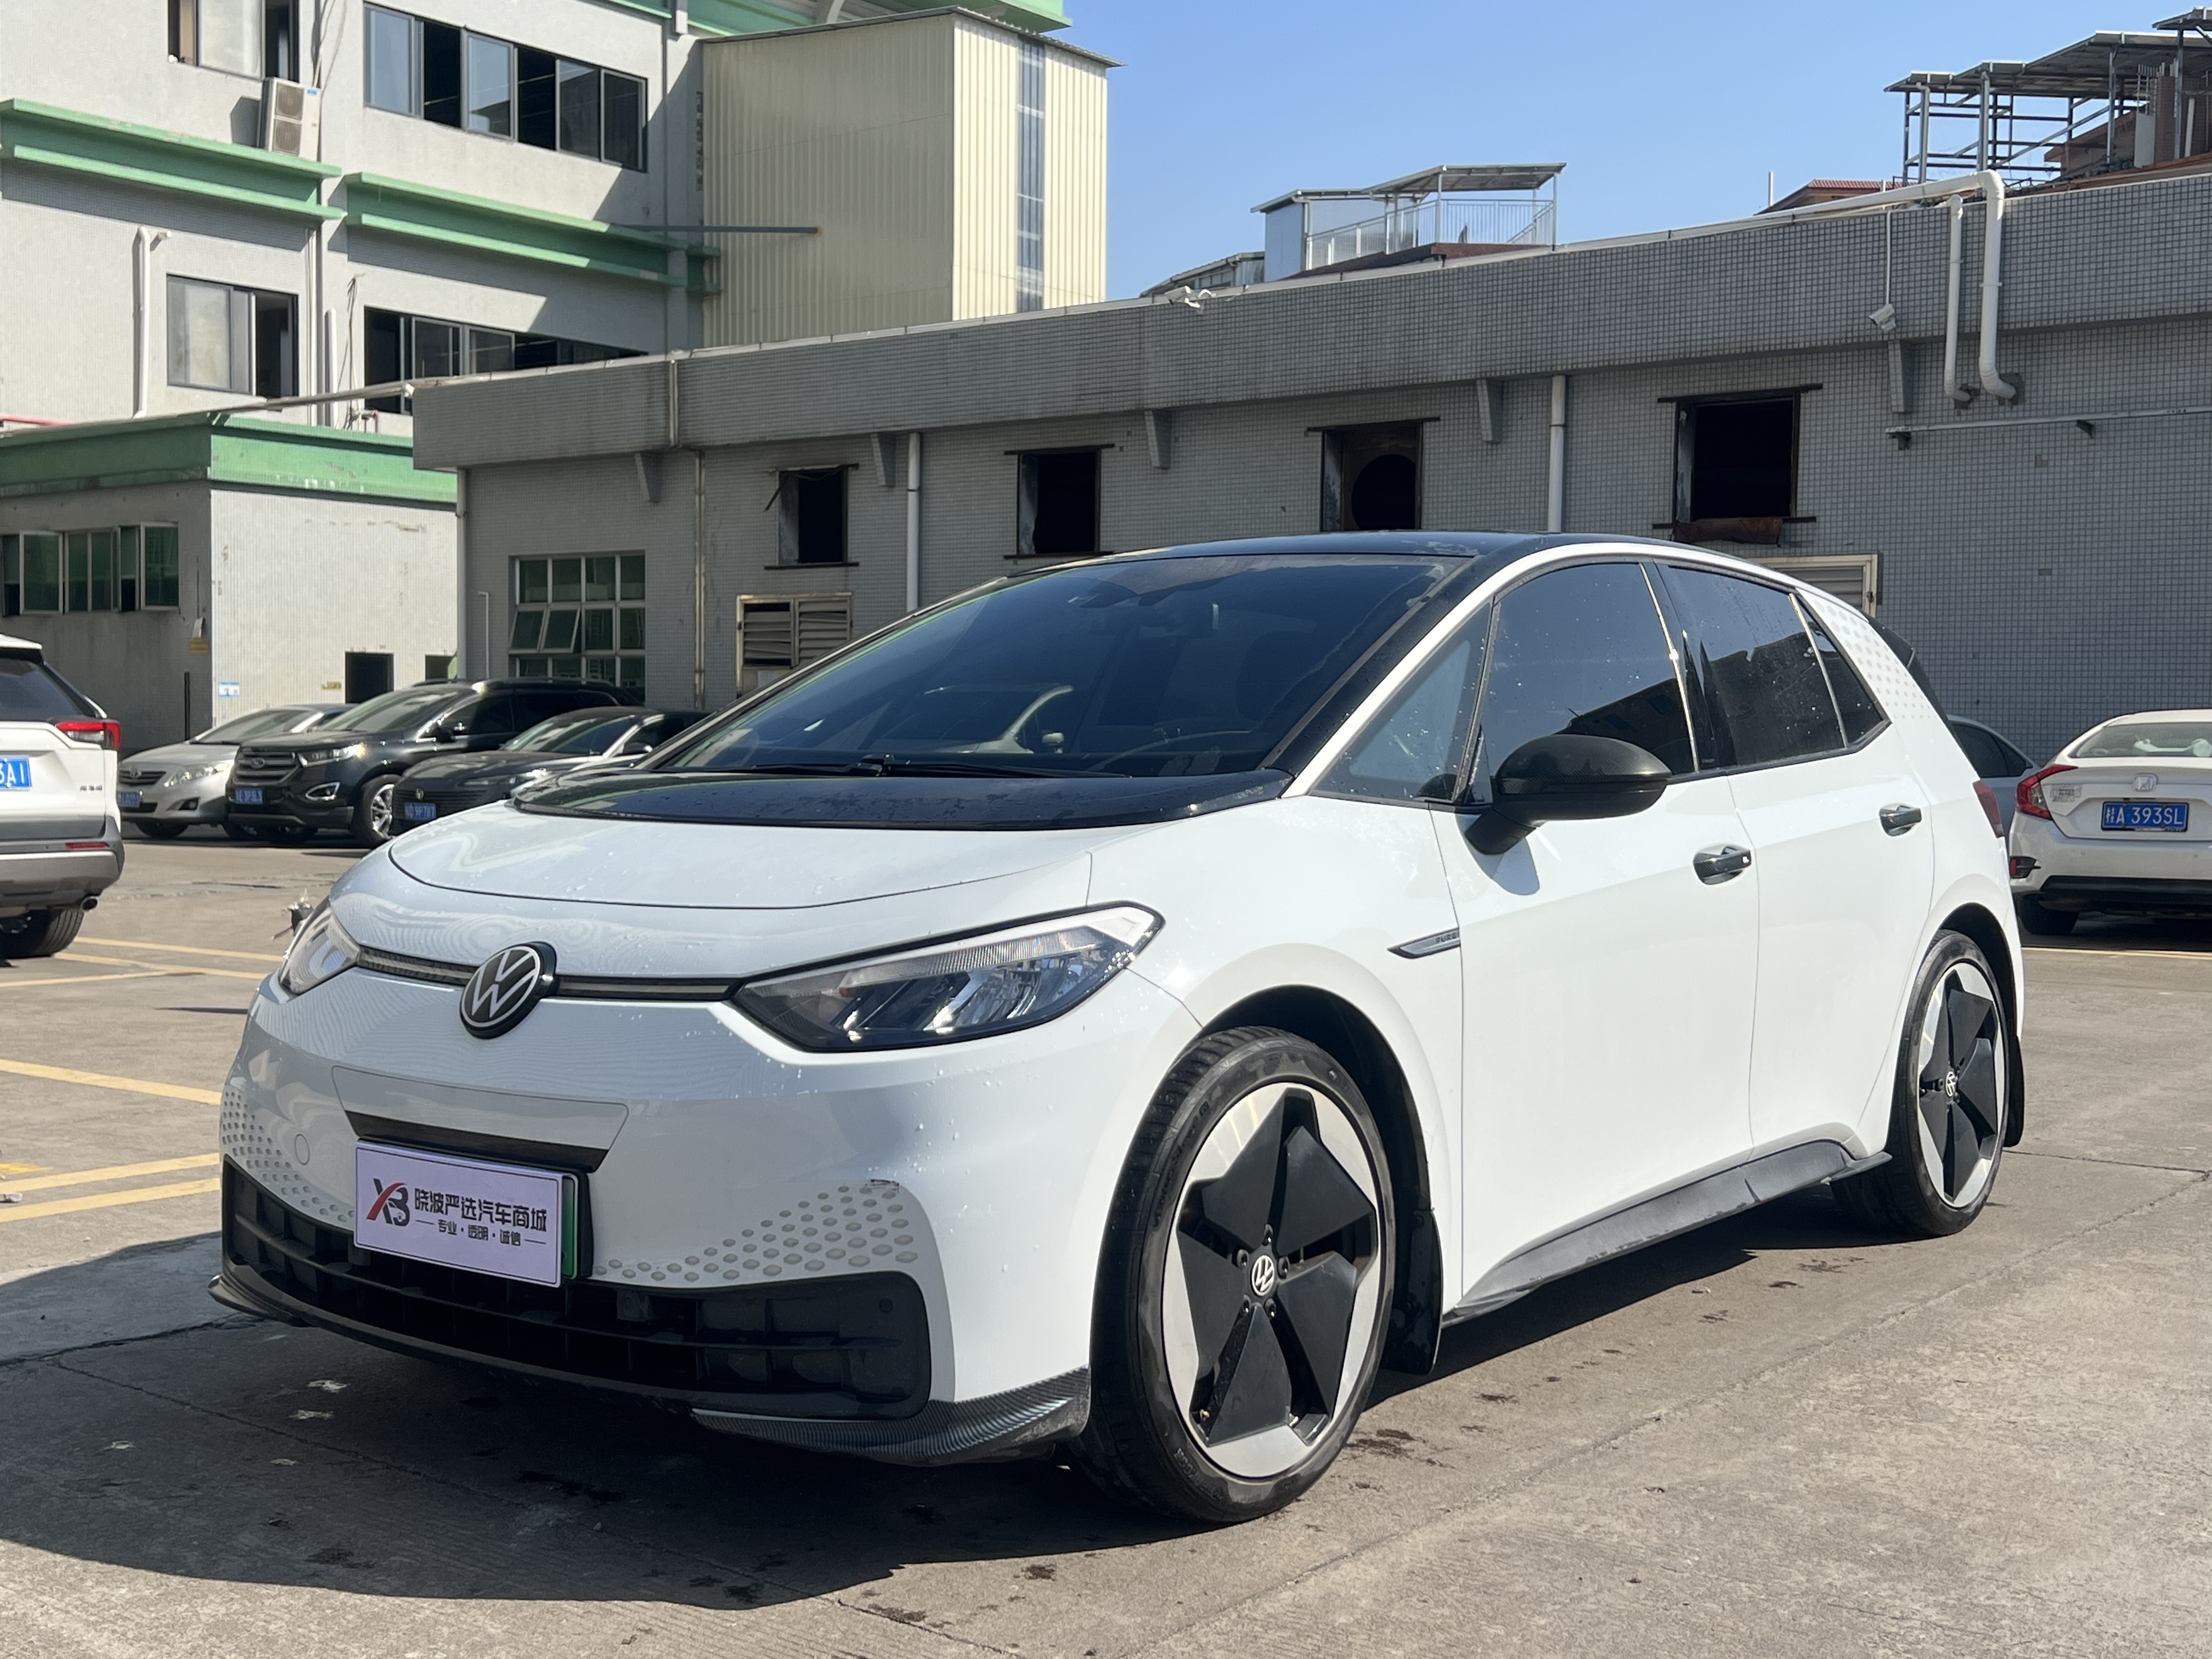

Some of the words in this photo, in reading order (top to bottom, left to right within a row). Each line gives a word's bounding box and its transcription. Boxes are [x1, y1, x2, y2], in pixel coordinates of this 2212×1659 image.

[2131, 807, 2183, 825] 393SL
[414, 1188, 548, 1232] 晓波严选汽车商城
